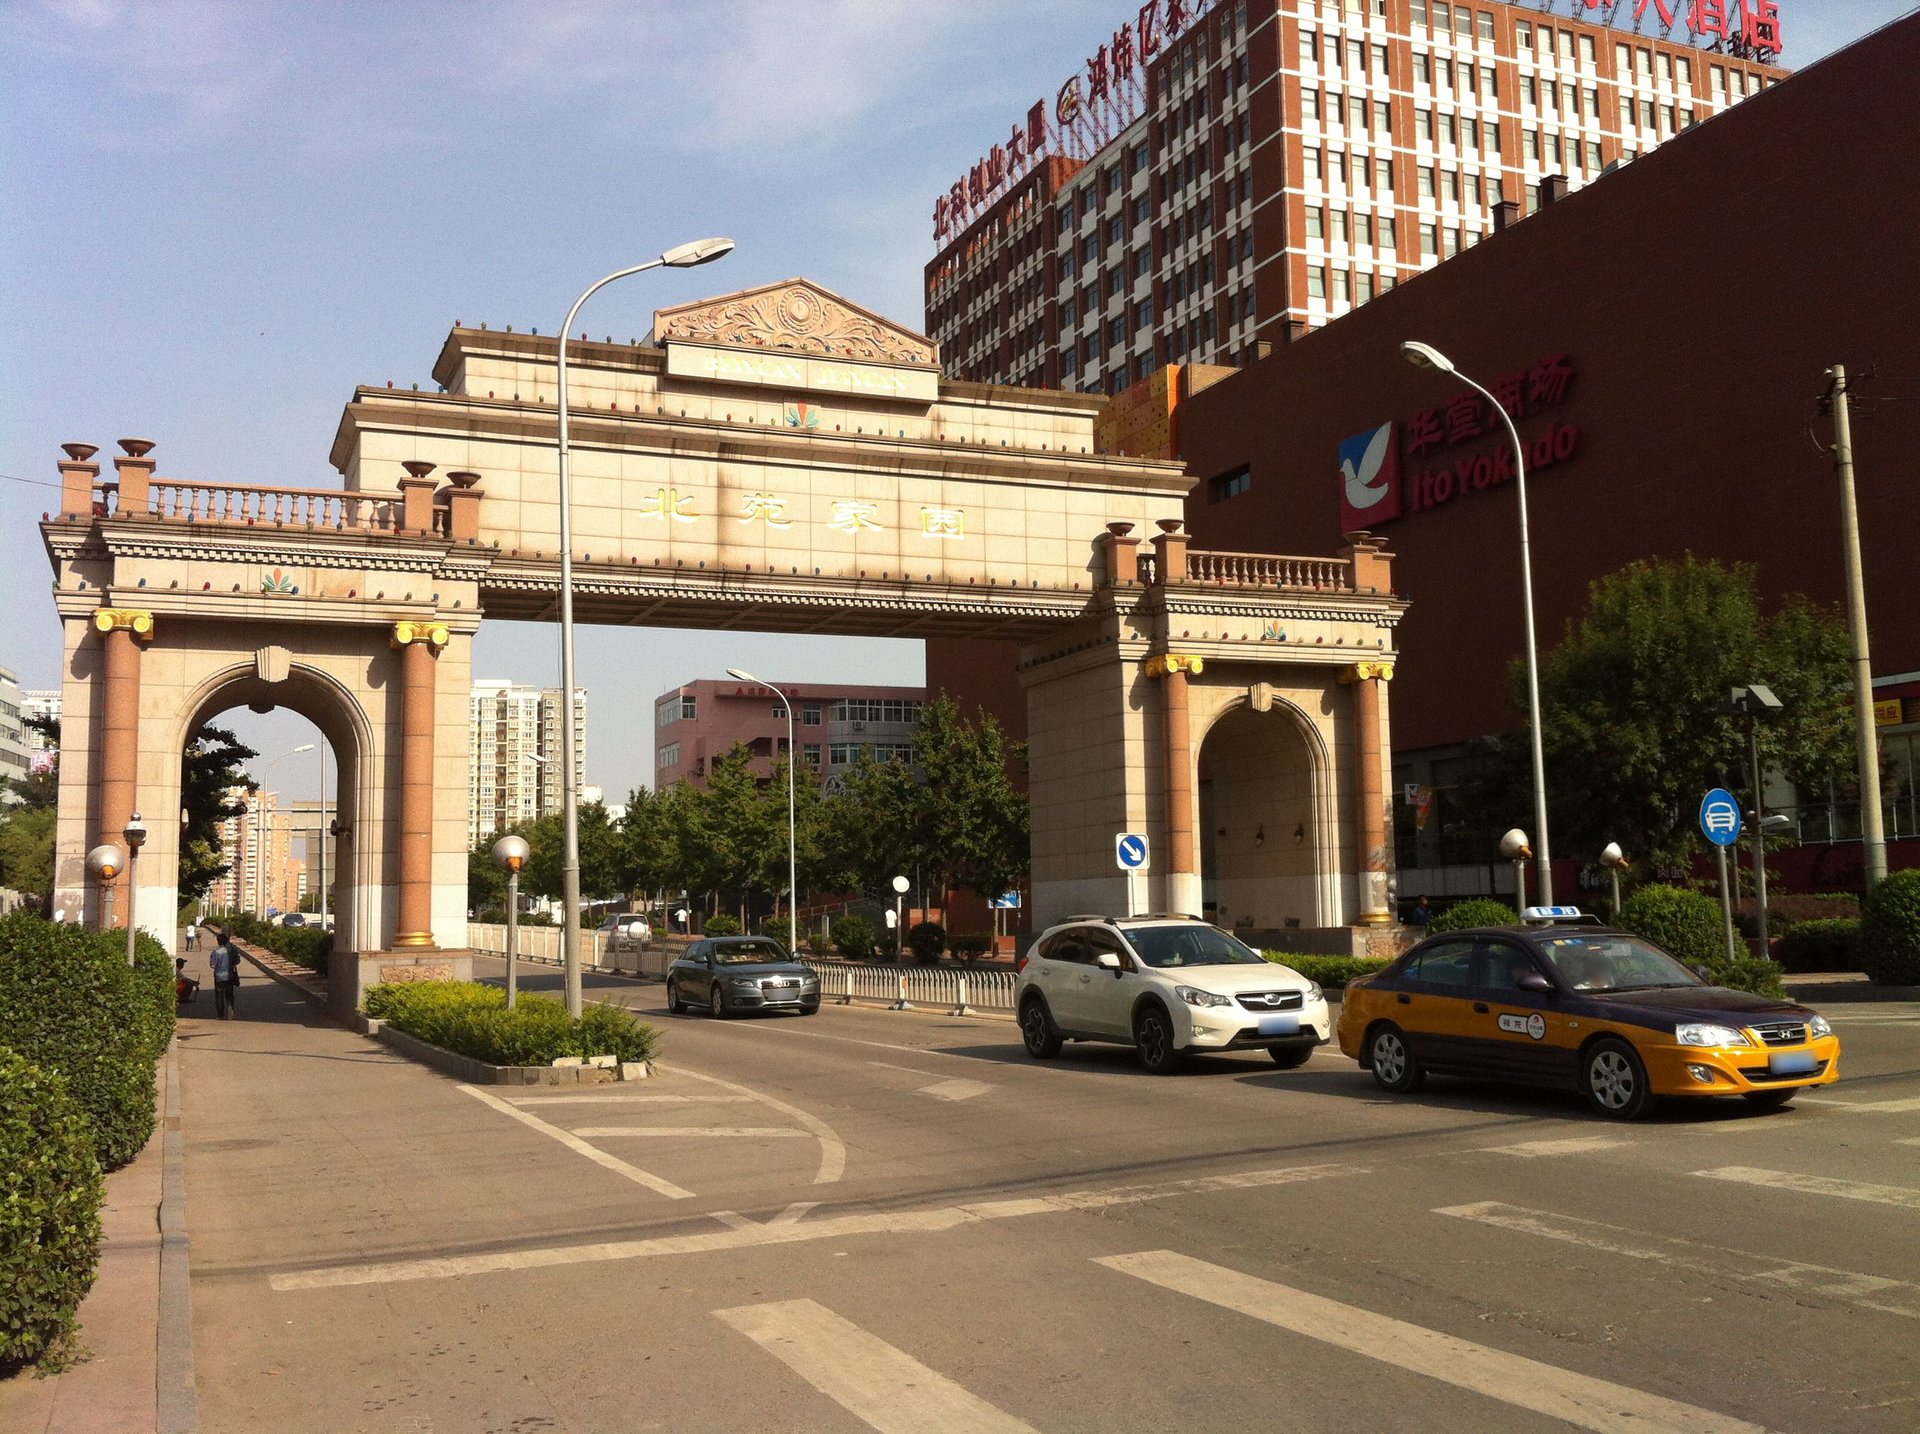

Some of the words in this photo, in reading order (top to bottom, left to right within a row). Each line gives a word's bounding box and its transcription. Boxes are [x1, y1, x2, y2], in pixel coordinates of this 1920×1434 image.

[1406, 351, 1573, 455] 华堂商场
[640, 488, 965, 538] 北苑家园
